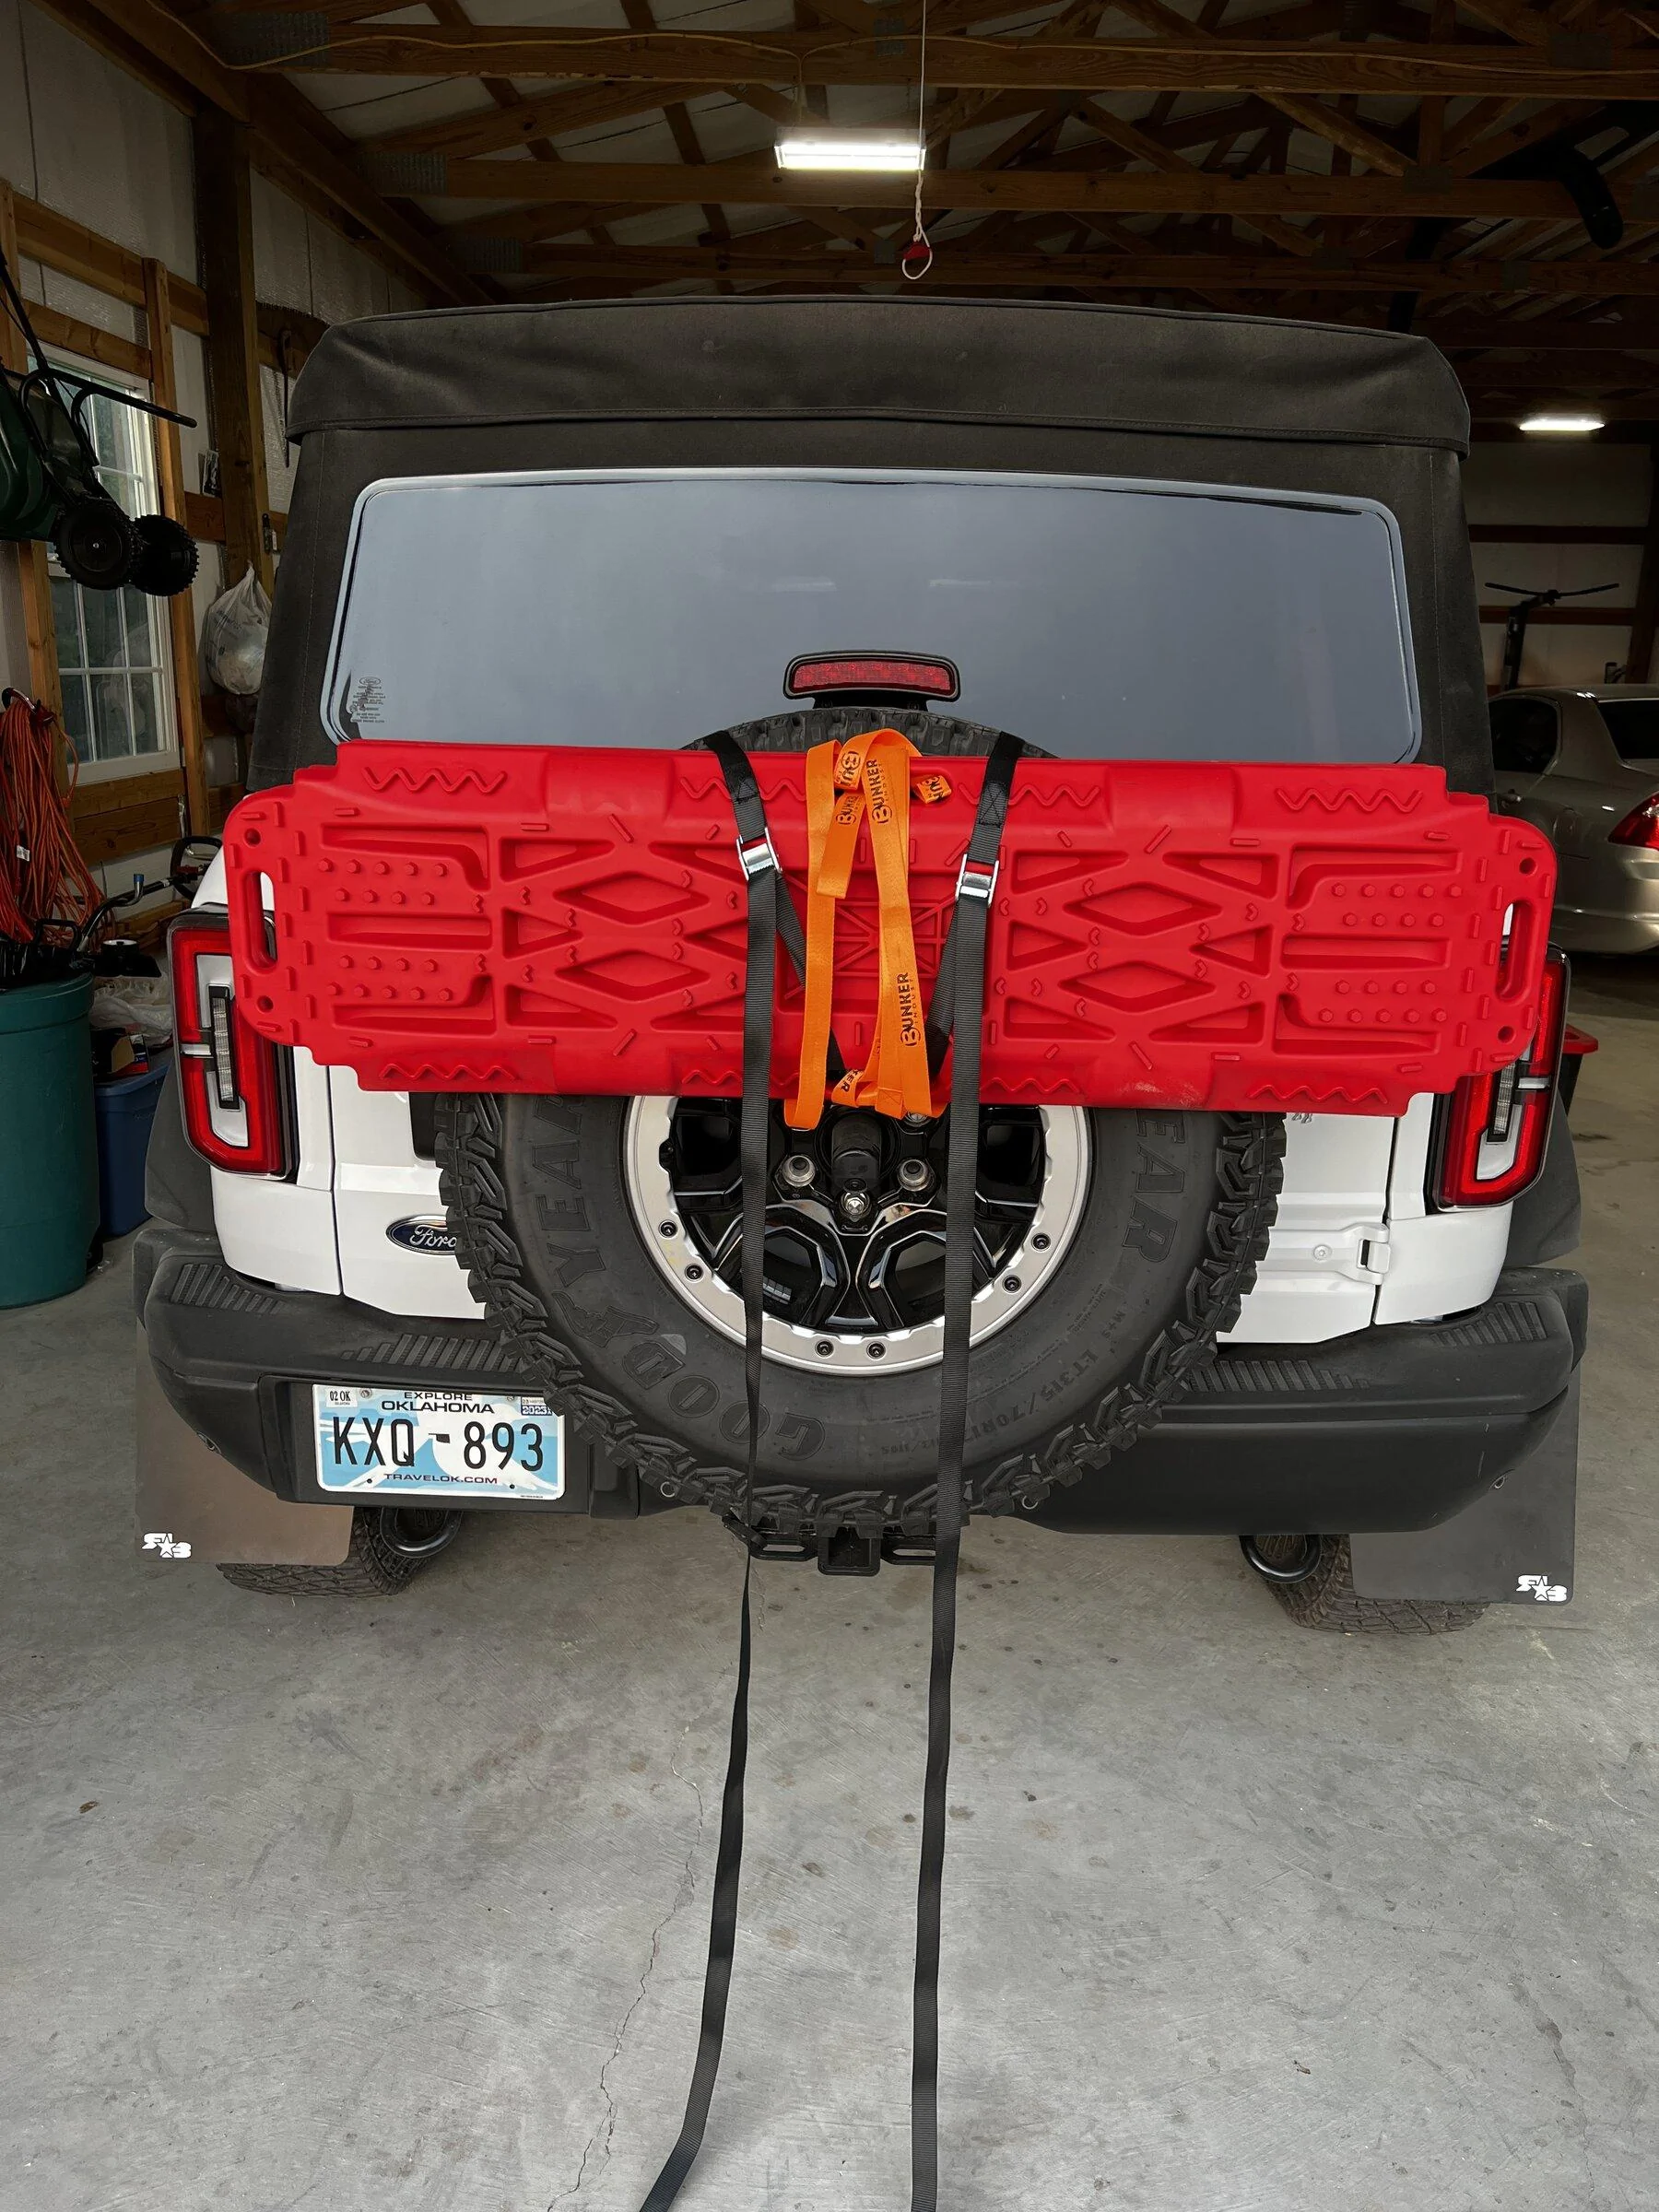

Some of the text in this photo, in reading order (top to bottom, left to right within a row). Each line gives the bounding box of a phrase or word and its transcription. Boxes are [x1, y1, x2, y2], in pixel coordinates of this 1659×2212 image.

[865, 759, 893, 825] BUNKER
[897, 971, 921, 1047] BUNKER
[329, 1390, 351, 1402] 02 OK
[404, 1391, 473, 1401] EXPLORE
[381, 1399, 495, 1414] OKLAHOMA
[333, 1417, 544, 1472] KXQ 893
[383, 1473, 498, 1485] TRAVELOK.COM
